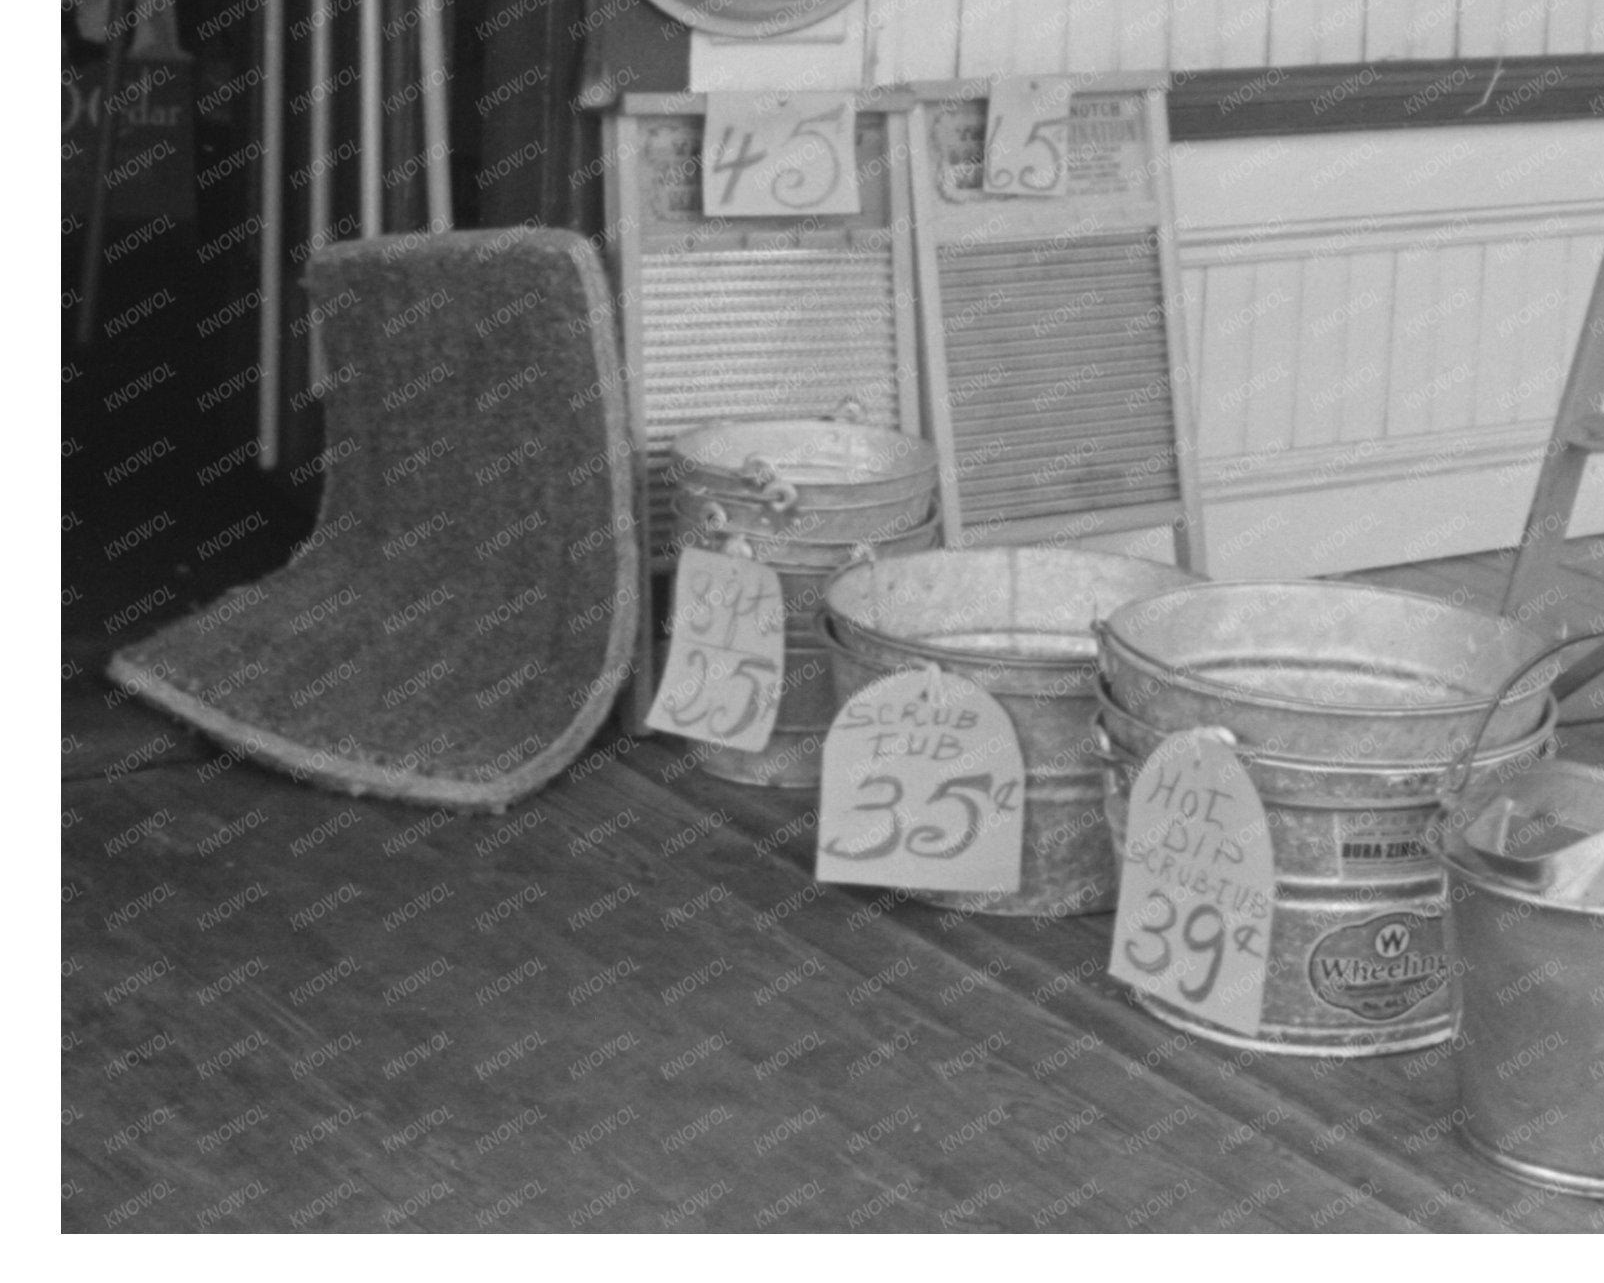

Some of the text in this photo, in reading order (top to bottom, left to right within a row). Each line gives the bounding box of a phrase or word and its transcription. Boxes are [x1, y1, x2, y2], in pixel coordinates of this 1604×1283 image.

[712, 105, 845, 209] 45
[838, 702, 979, 730] SCRUB
[868, 732, 964, 760] TUB
[1146, 766, 1233, 830] HOT
[1162, 819, 1245, 864] DIP
[1380, 929, 1406, 954] W
